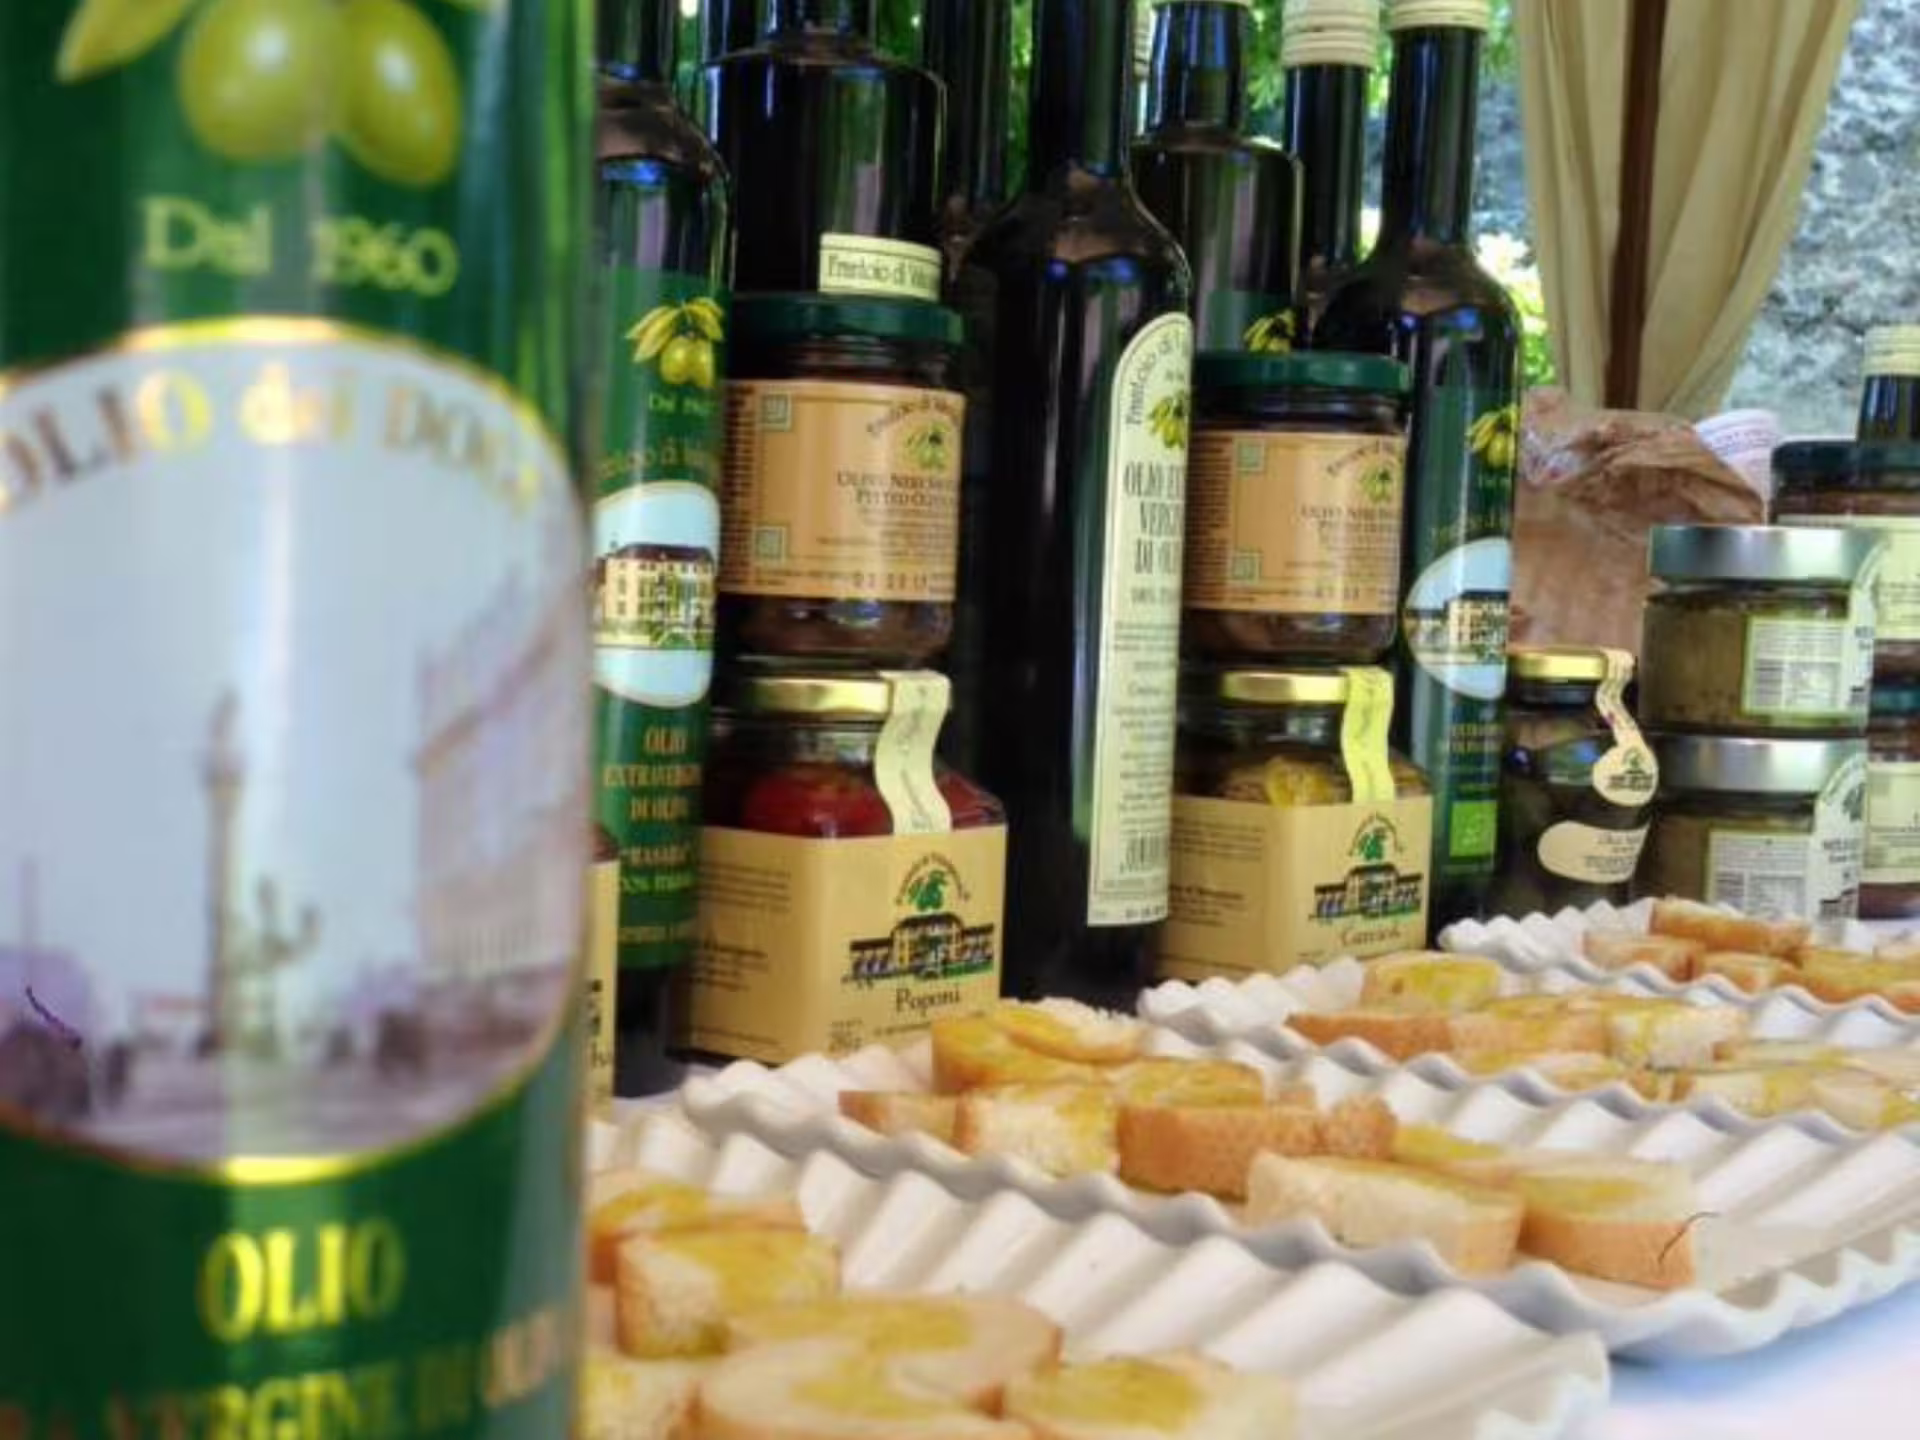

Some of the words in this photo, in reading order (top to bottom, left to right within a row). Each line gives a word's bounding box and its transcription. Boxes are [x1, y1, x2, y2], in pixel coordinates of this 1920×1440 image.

[143, 197, 272, 275] Dal
[313, 216, 459, 296] 1960
[202, 1219, 404, 1342] OLIO
